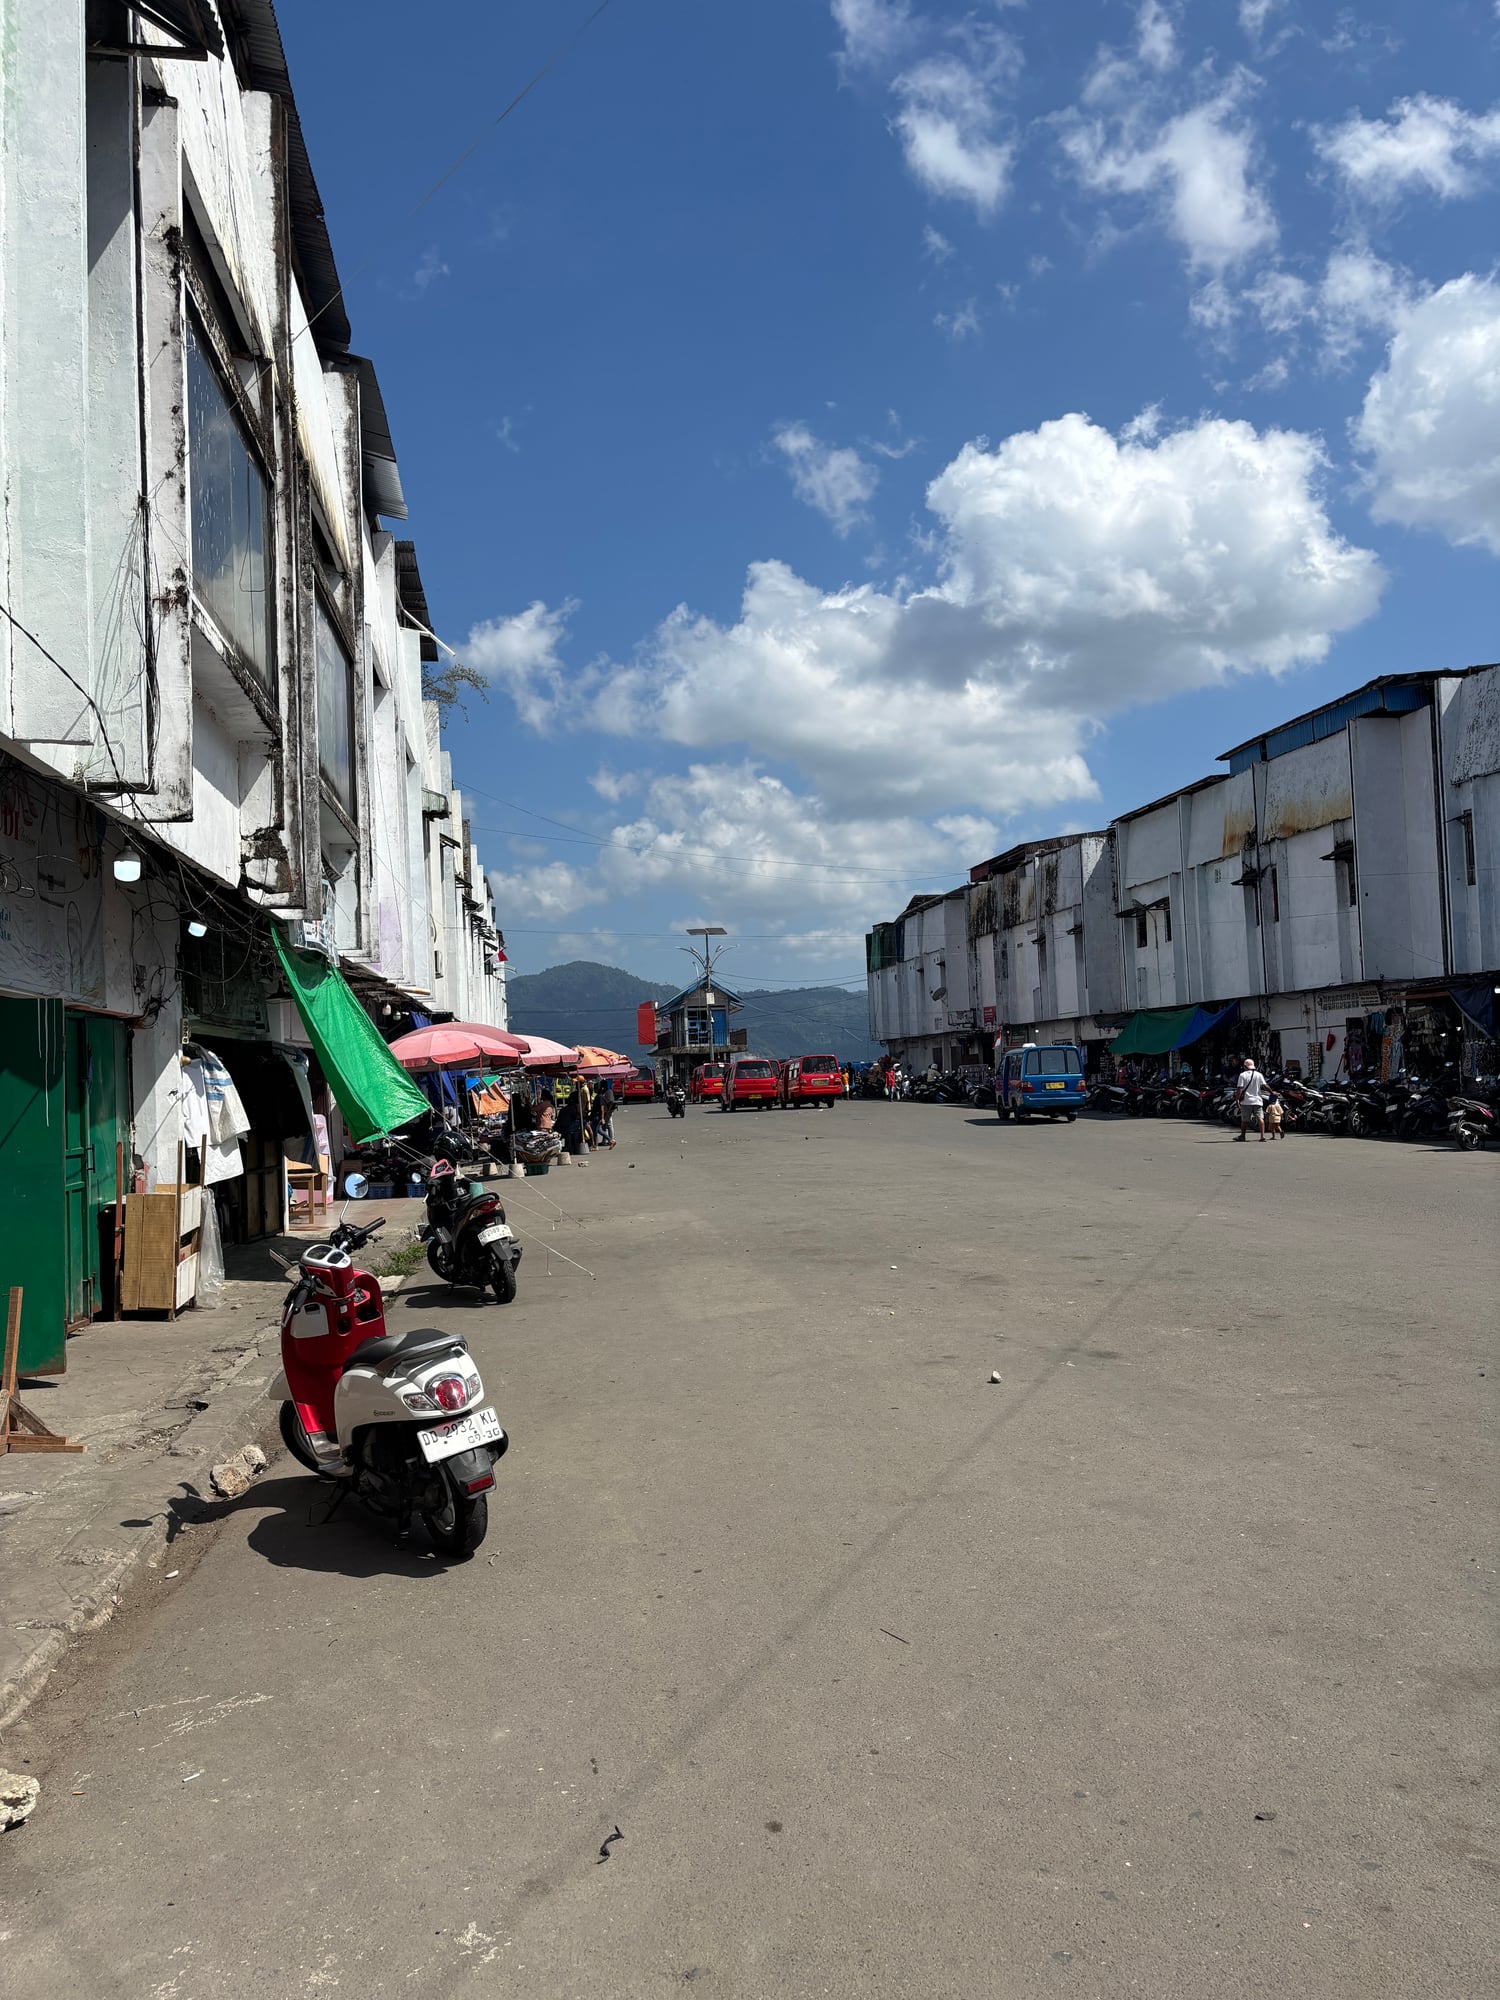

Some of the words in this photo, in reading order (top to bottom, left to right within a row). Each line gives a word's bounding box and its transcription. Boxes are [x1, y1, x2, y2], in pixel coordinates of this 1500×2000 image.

[421, 1431, 439, 1446] DD
[443, 1418, 475, 1439] 2932
[479, 1411, 497, 1425] KL
